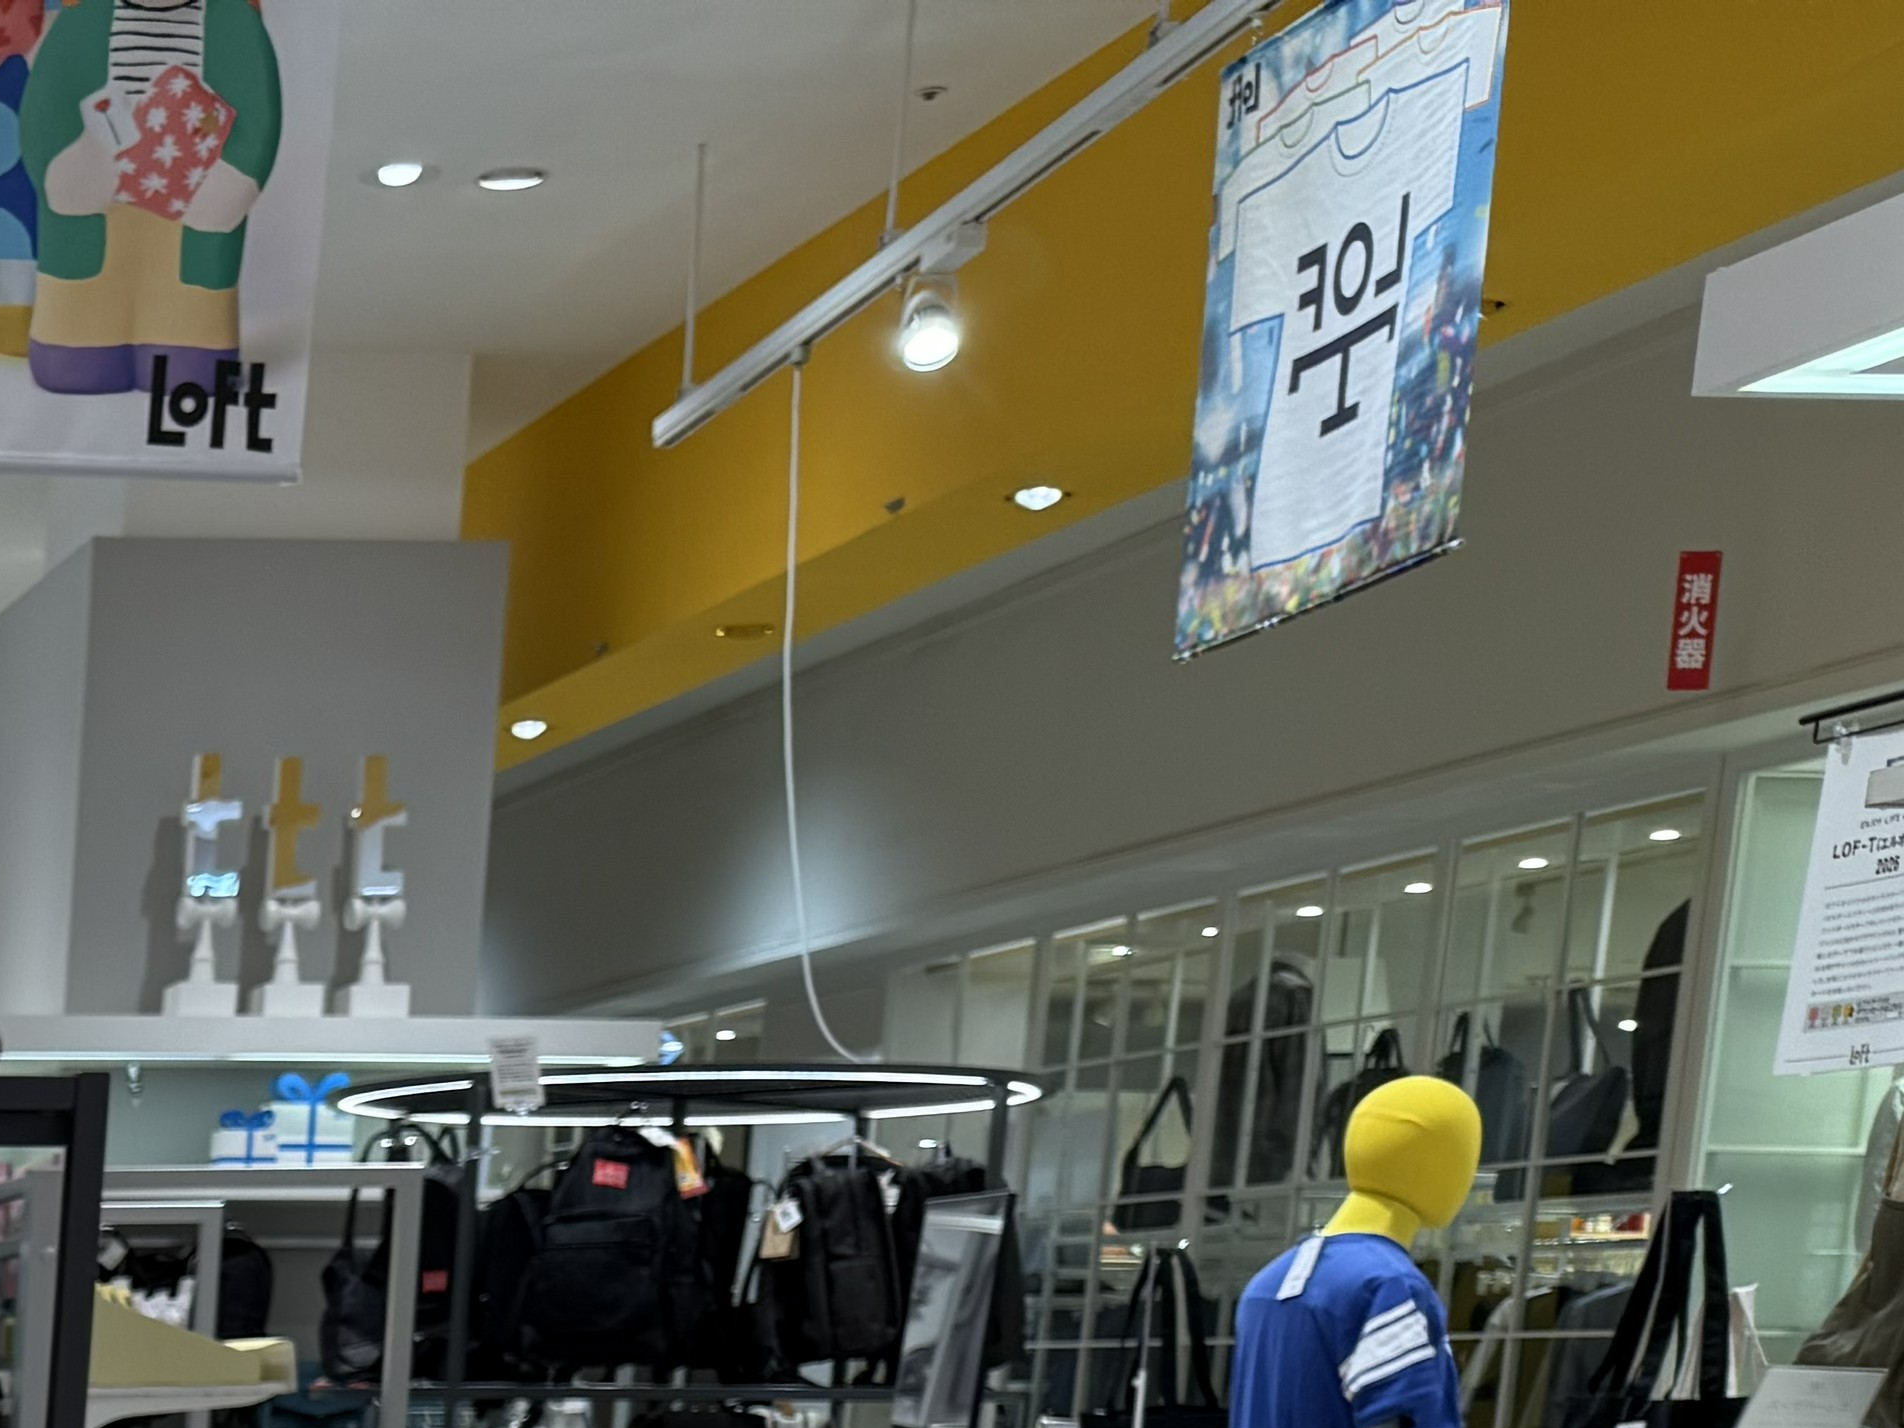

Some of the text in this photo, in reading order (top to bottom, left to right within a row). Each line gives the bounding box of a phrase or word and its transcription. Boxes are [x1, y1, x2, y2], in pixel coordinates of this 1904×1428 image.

[146, 355, 277, 452] Loft
[1674, 573, 1713, 670] 消火器
